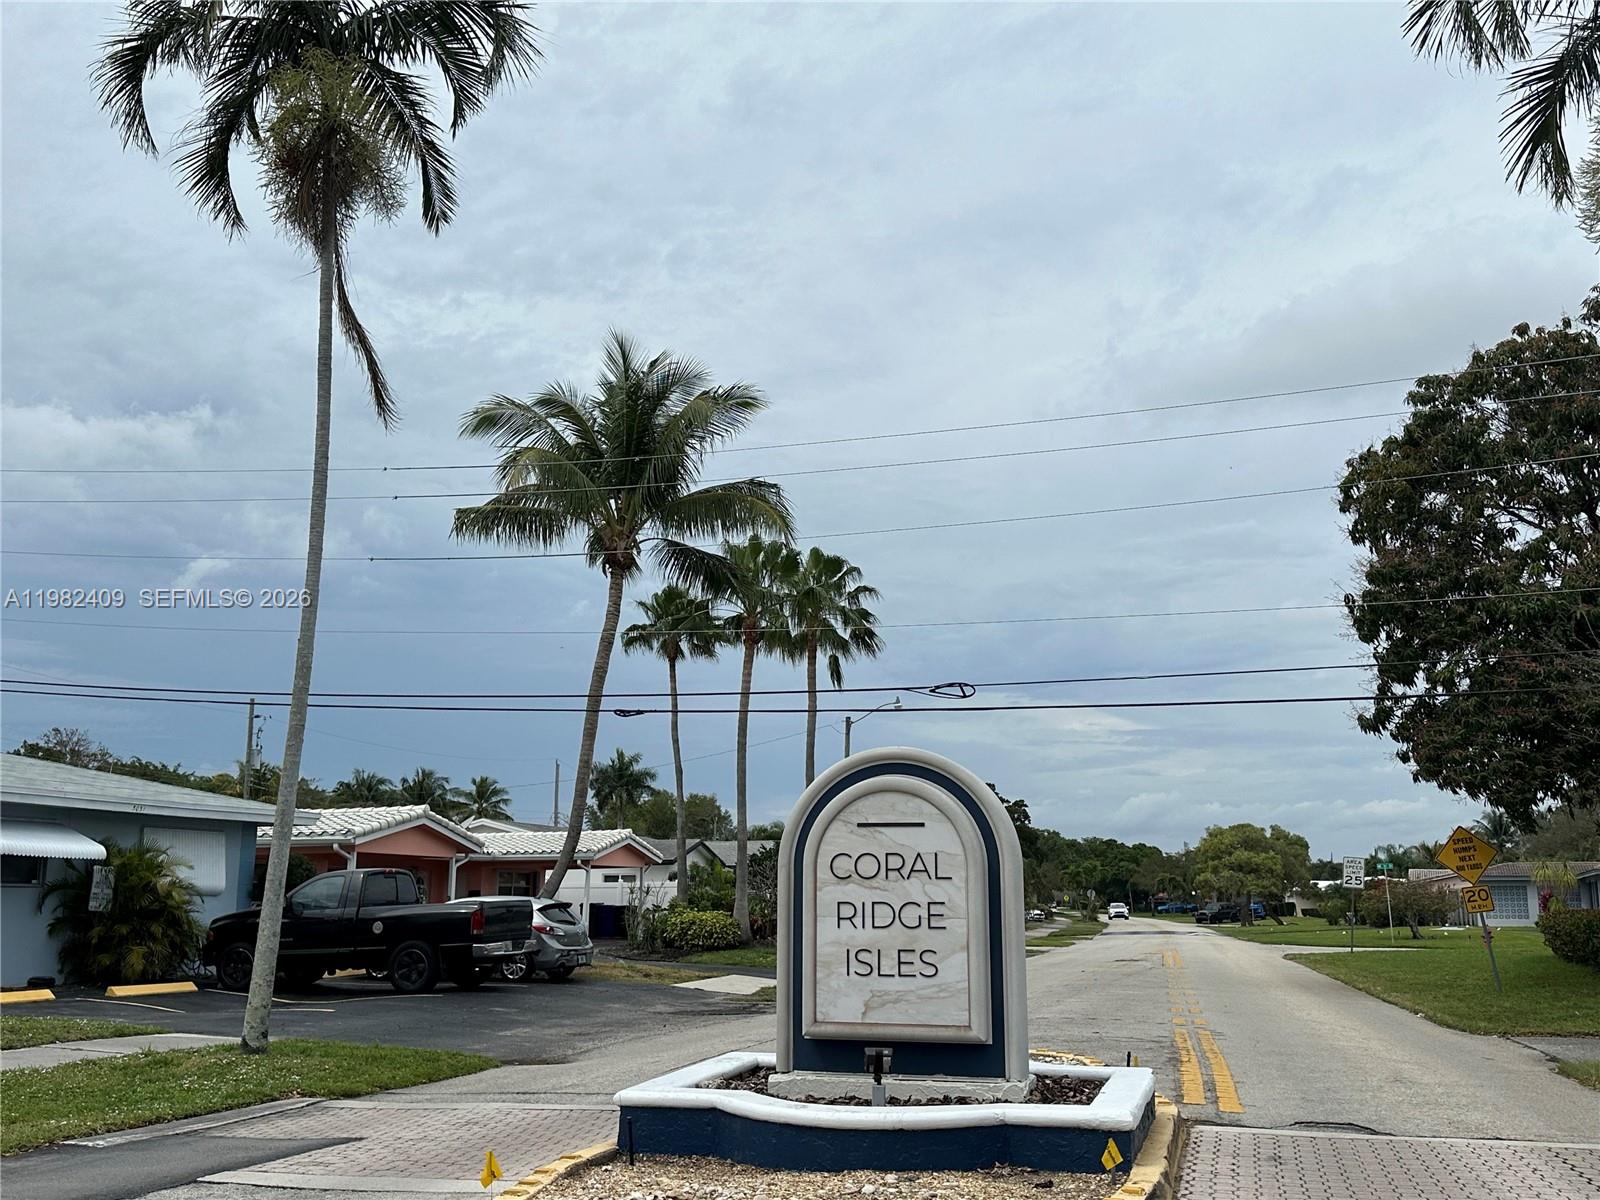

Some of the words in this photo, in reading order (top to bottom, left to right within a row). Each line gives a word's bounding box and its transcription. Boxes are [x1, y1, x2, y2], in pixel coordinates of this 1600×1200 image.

[1452, 837, 1473, 845] SPEED
[1453, 845, 1477, 854] HUMPS
[829, 852, 953, 881] CORAL
[1345, 875, 1363, 885] 25
[1465, 888, 1489, 903] 20
[836, 901, 947, 930] RIDGE
[845, 948, 939, 978] ISLES
